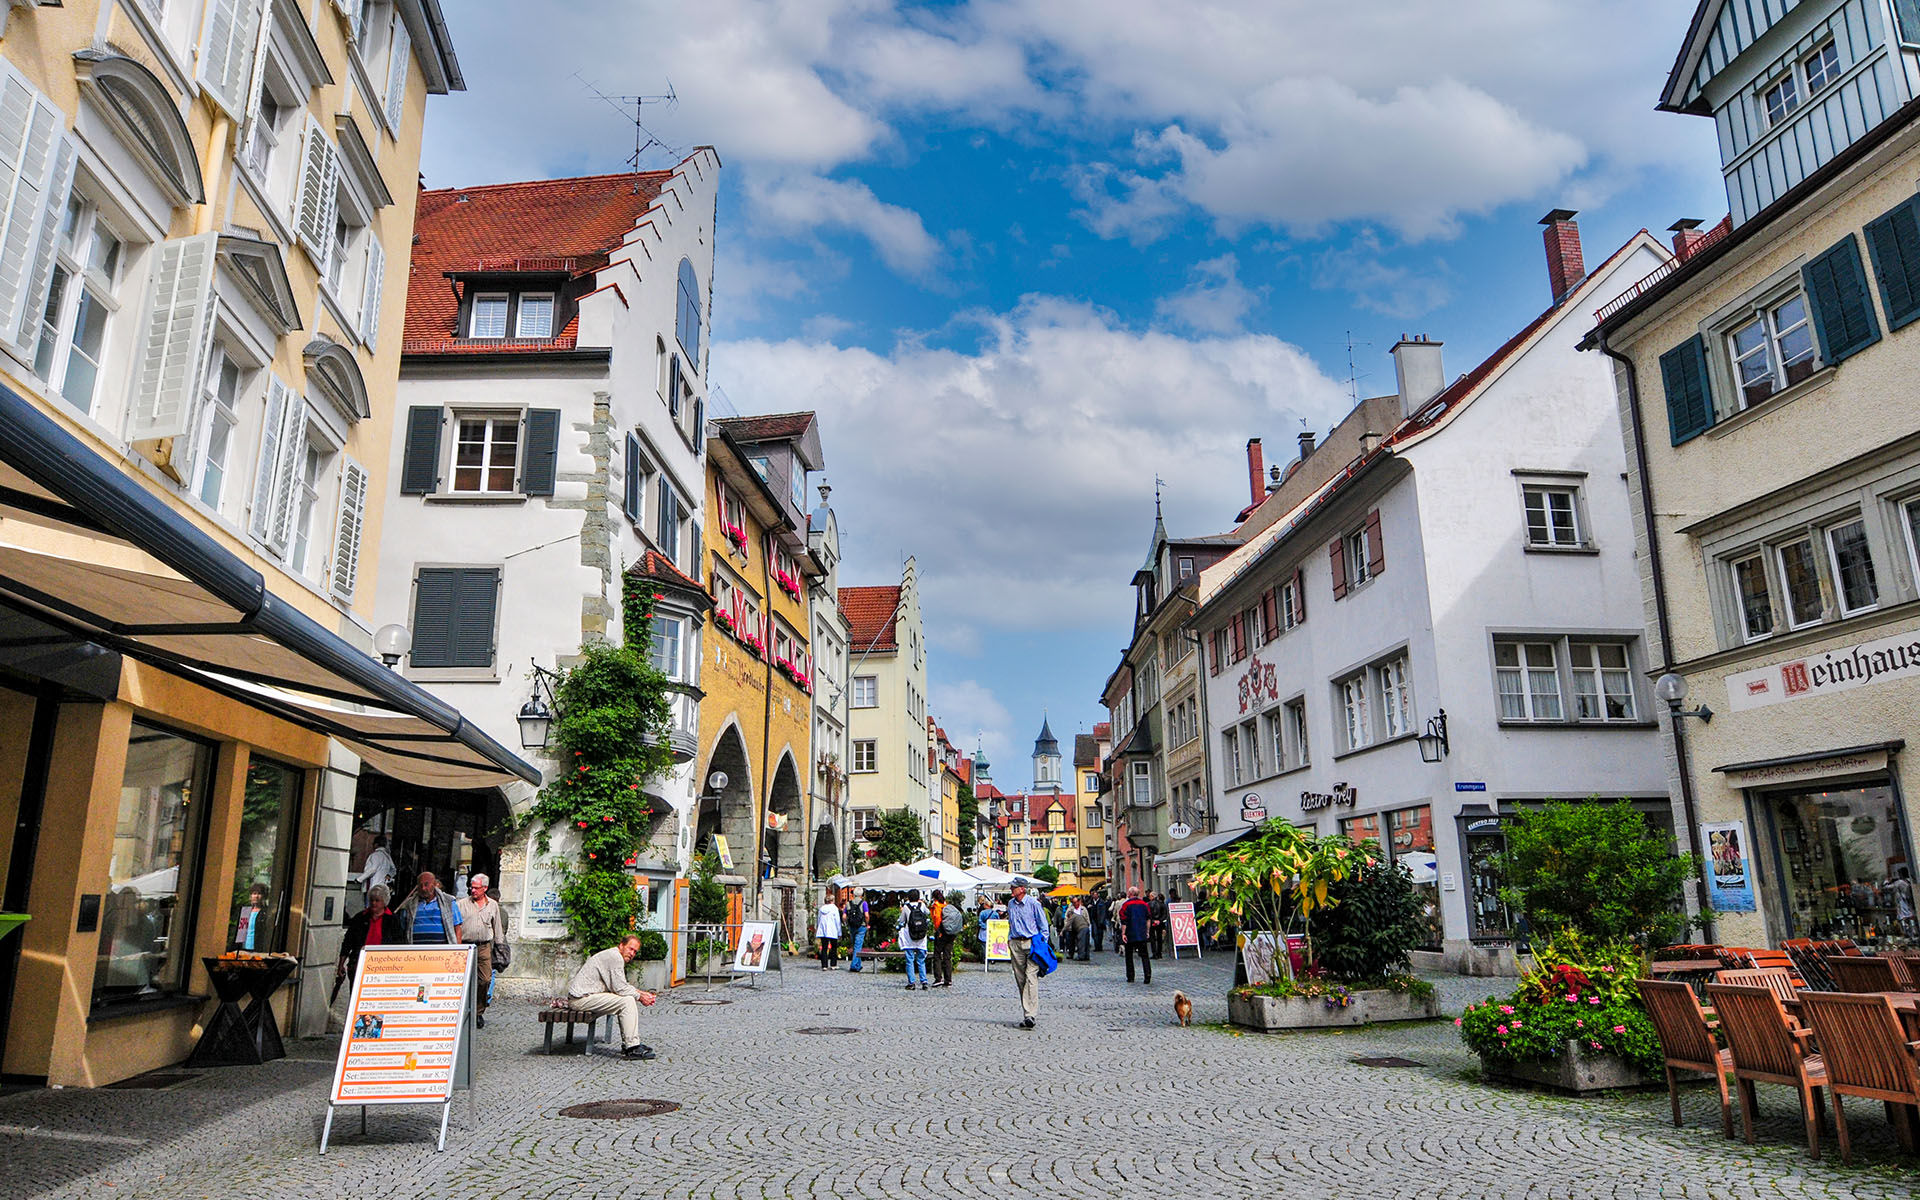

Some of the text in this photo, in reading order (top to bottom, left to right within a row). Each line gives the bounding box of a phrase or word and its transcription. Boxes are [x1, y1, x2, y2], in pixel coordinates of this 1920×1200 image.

[1781, 642, 1920, 695] Weinhaus
[368, 955, 403, 963] Angebote
[365, 964, 404, 973] September
[345, 1072, 360, 1080] Set:
[342, 1087, 357, 1095] Set:
